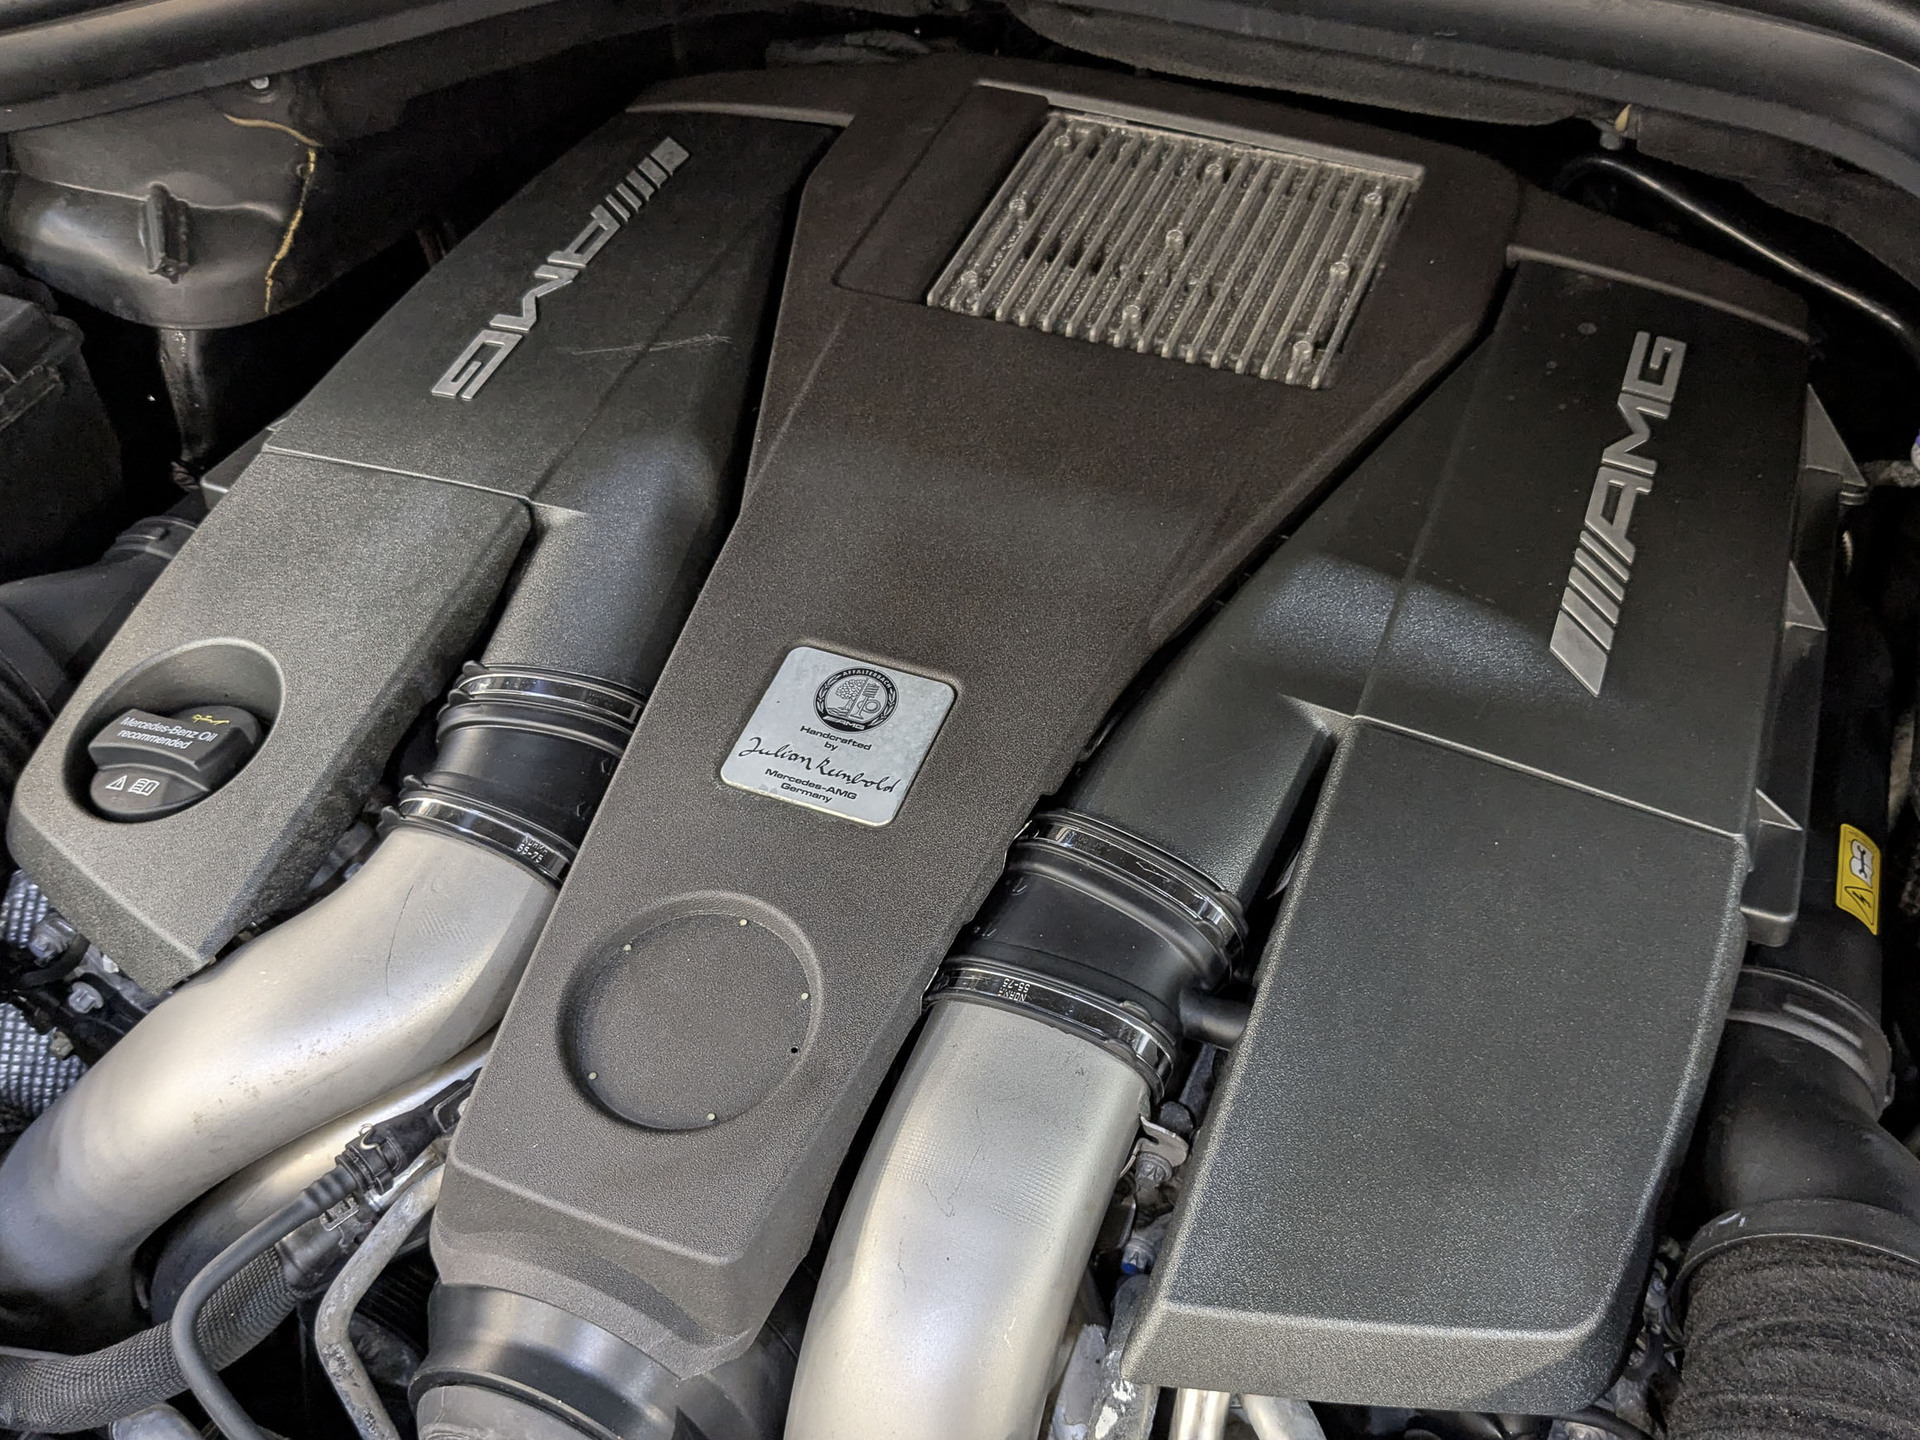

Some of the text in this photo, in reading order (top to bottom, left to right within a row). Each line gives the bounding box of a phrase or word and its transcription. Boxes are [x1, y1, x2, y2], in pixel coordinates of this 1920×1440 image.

[431, 203, 621, 401] AMG
[842, 669, 893, 689] AFFALTERBACH
[117, 728, 193, 750] recommended
[119, 716, 218, 742] Mercedes-Benz Oil
[799, 725, 872, 751] Handcrafted
[738, 736, 812, 771] Julian
[823, 741, 839, 751] by
[764, 768, 858, 800] Mercedes-AMG
[780, 782, 832, 803] Germany
[1002, 978, 1031, 993] 55-75
